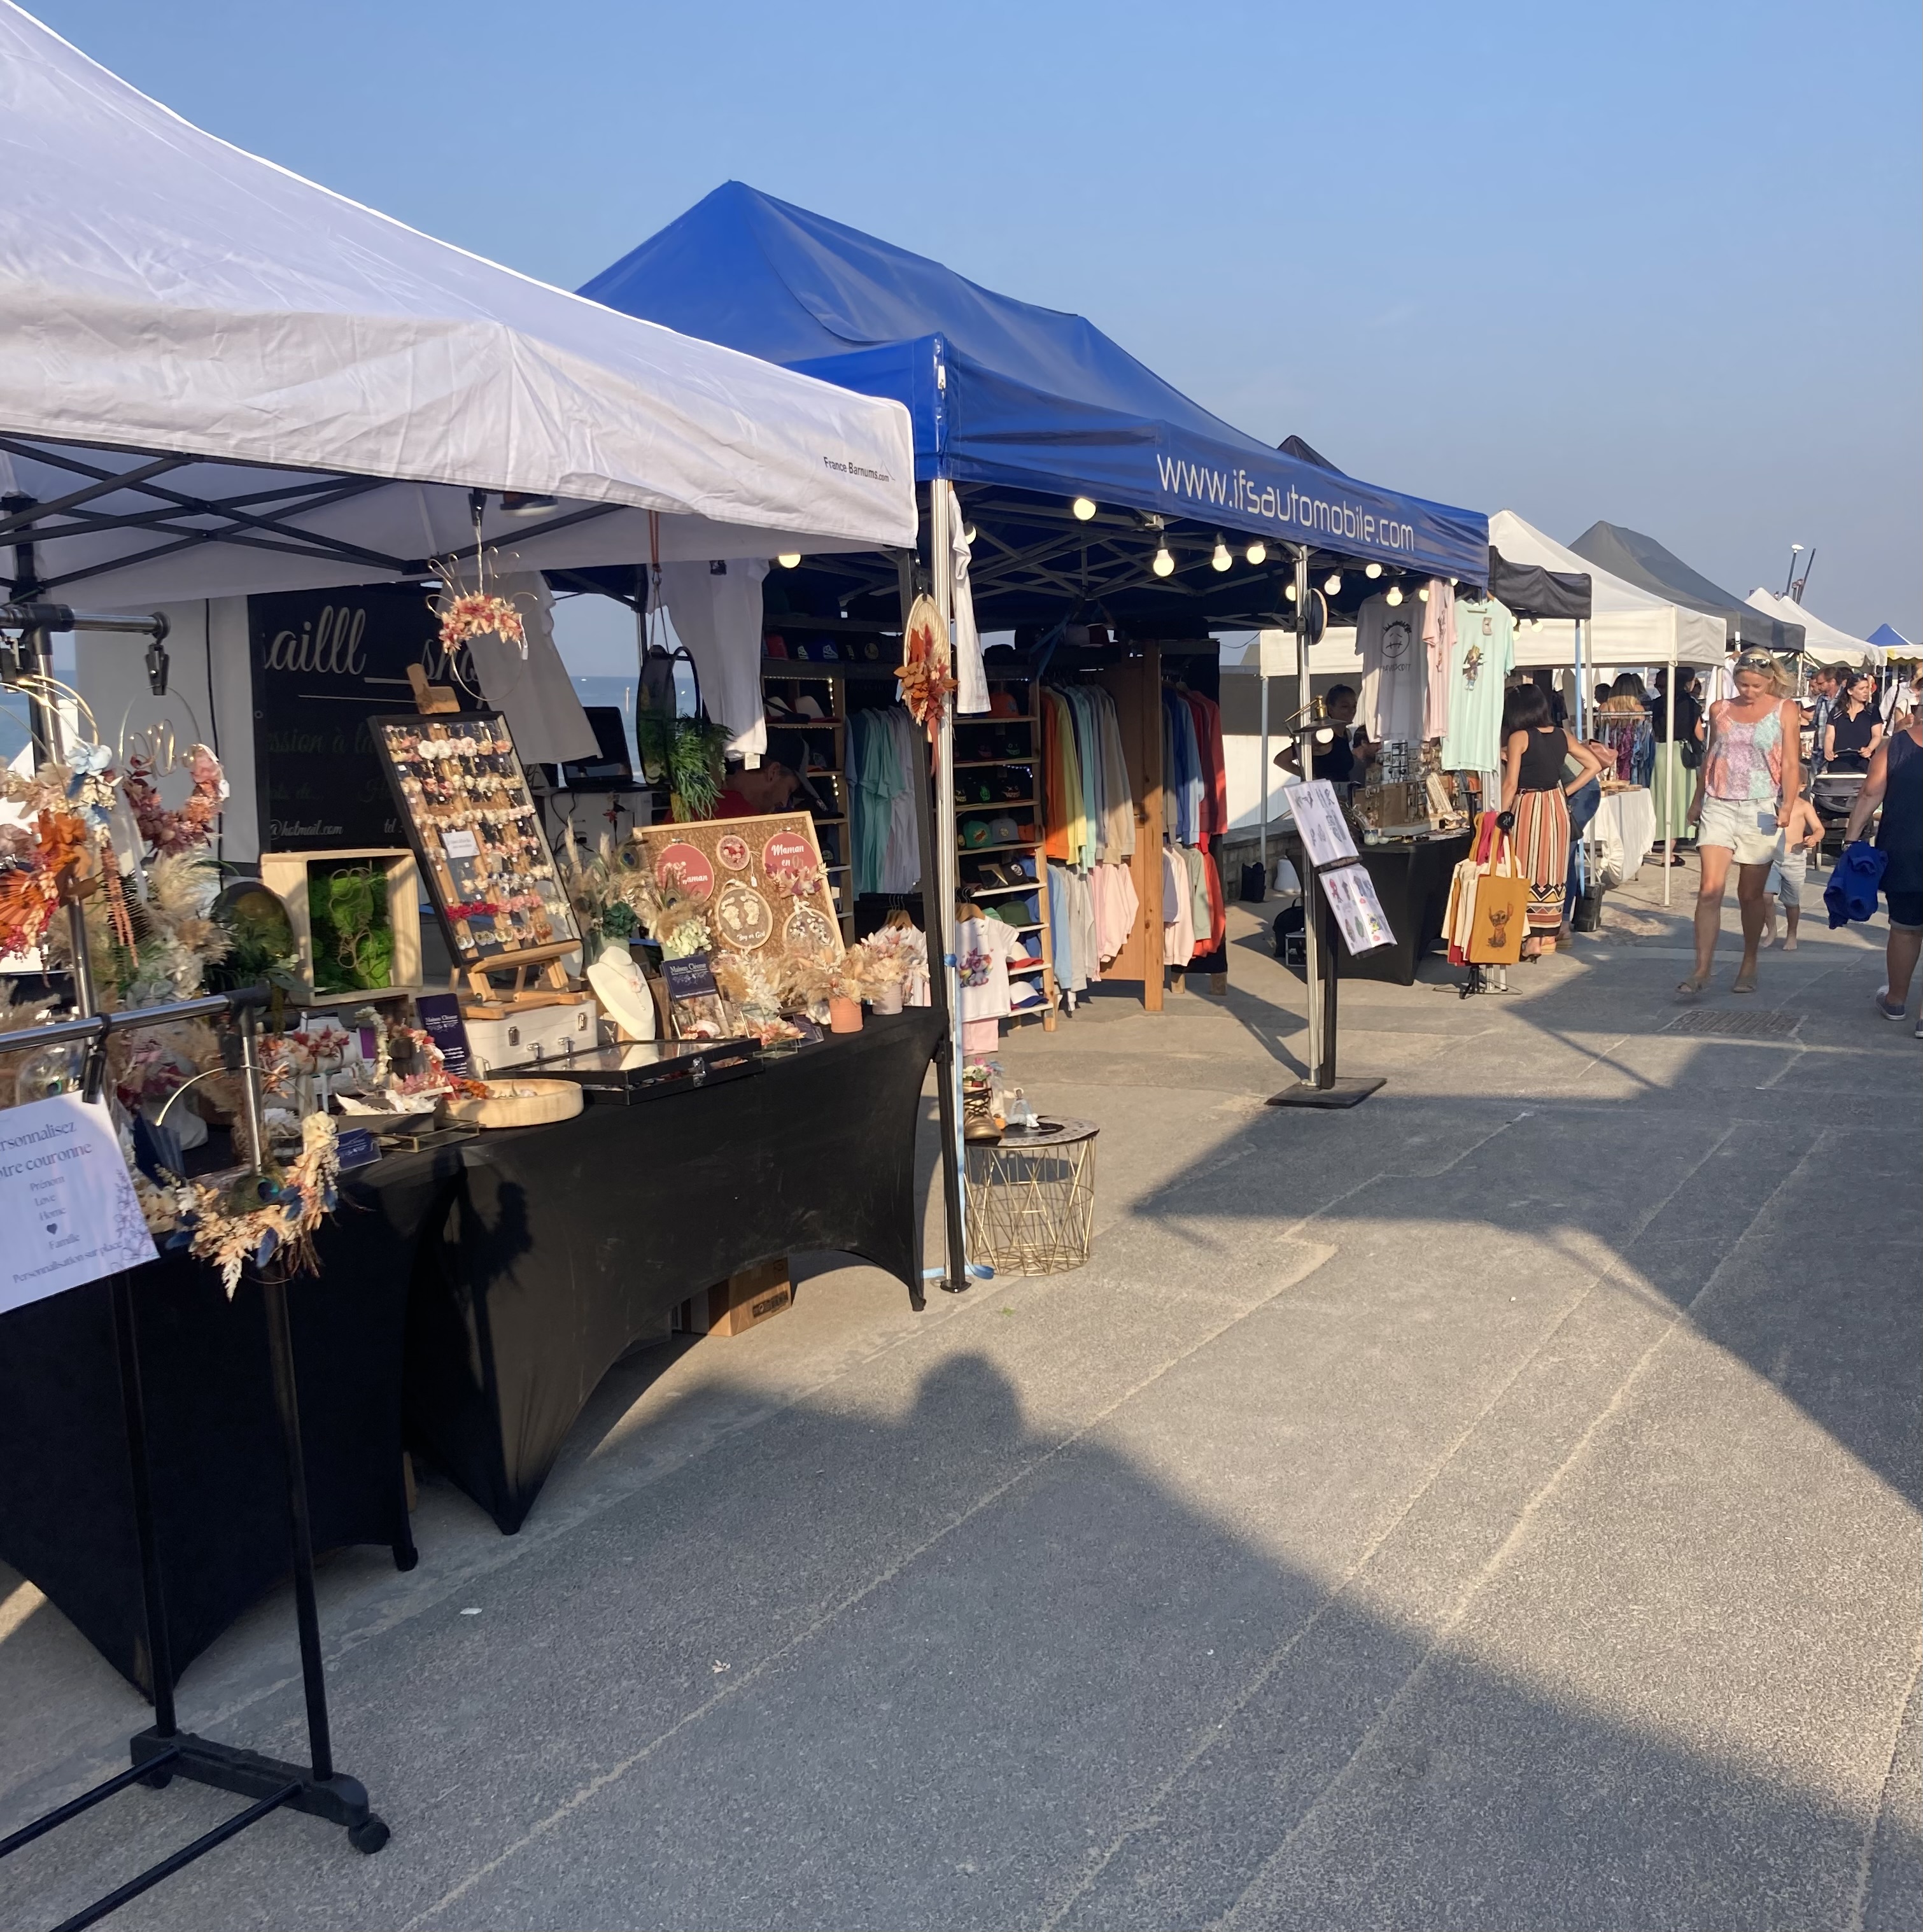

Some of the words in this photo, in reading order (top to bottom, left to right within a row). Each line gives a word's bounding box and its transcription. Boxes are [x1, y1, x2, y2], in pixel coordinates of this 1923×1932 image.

[823, 456, 847, 473] France
[848, 462, 890, 483] Barnums.com
[265, 605, 367, 675] ailll
[771, 843, 805, 856] Maman
[0, 1122, 77, 1152] rsonnalisez
[25, 1143, 92, 1171] couronne
